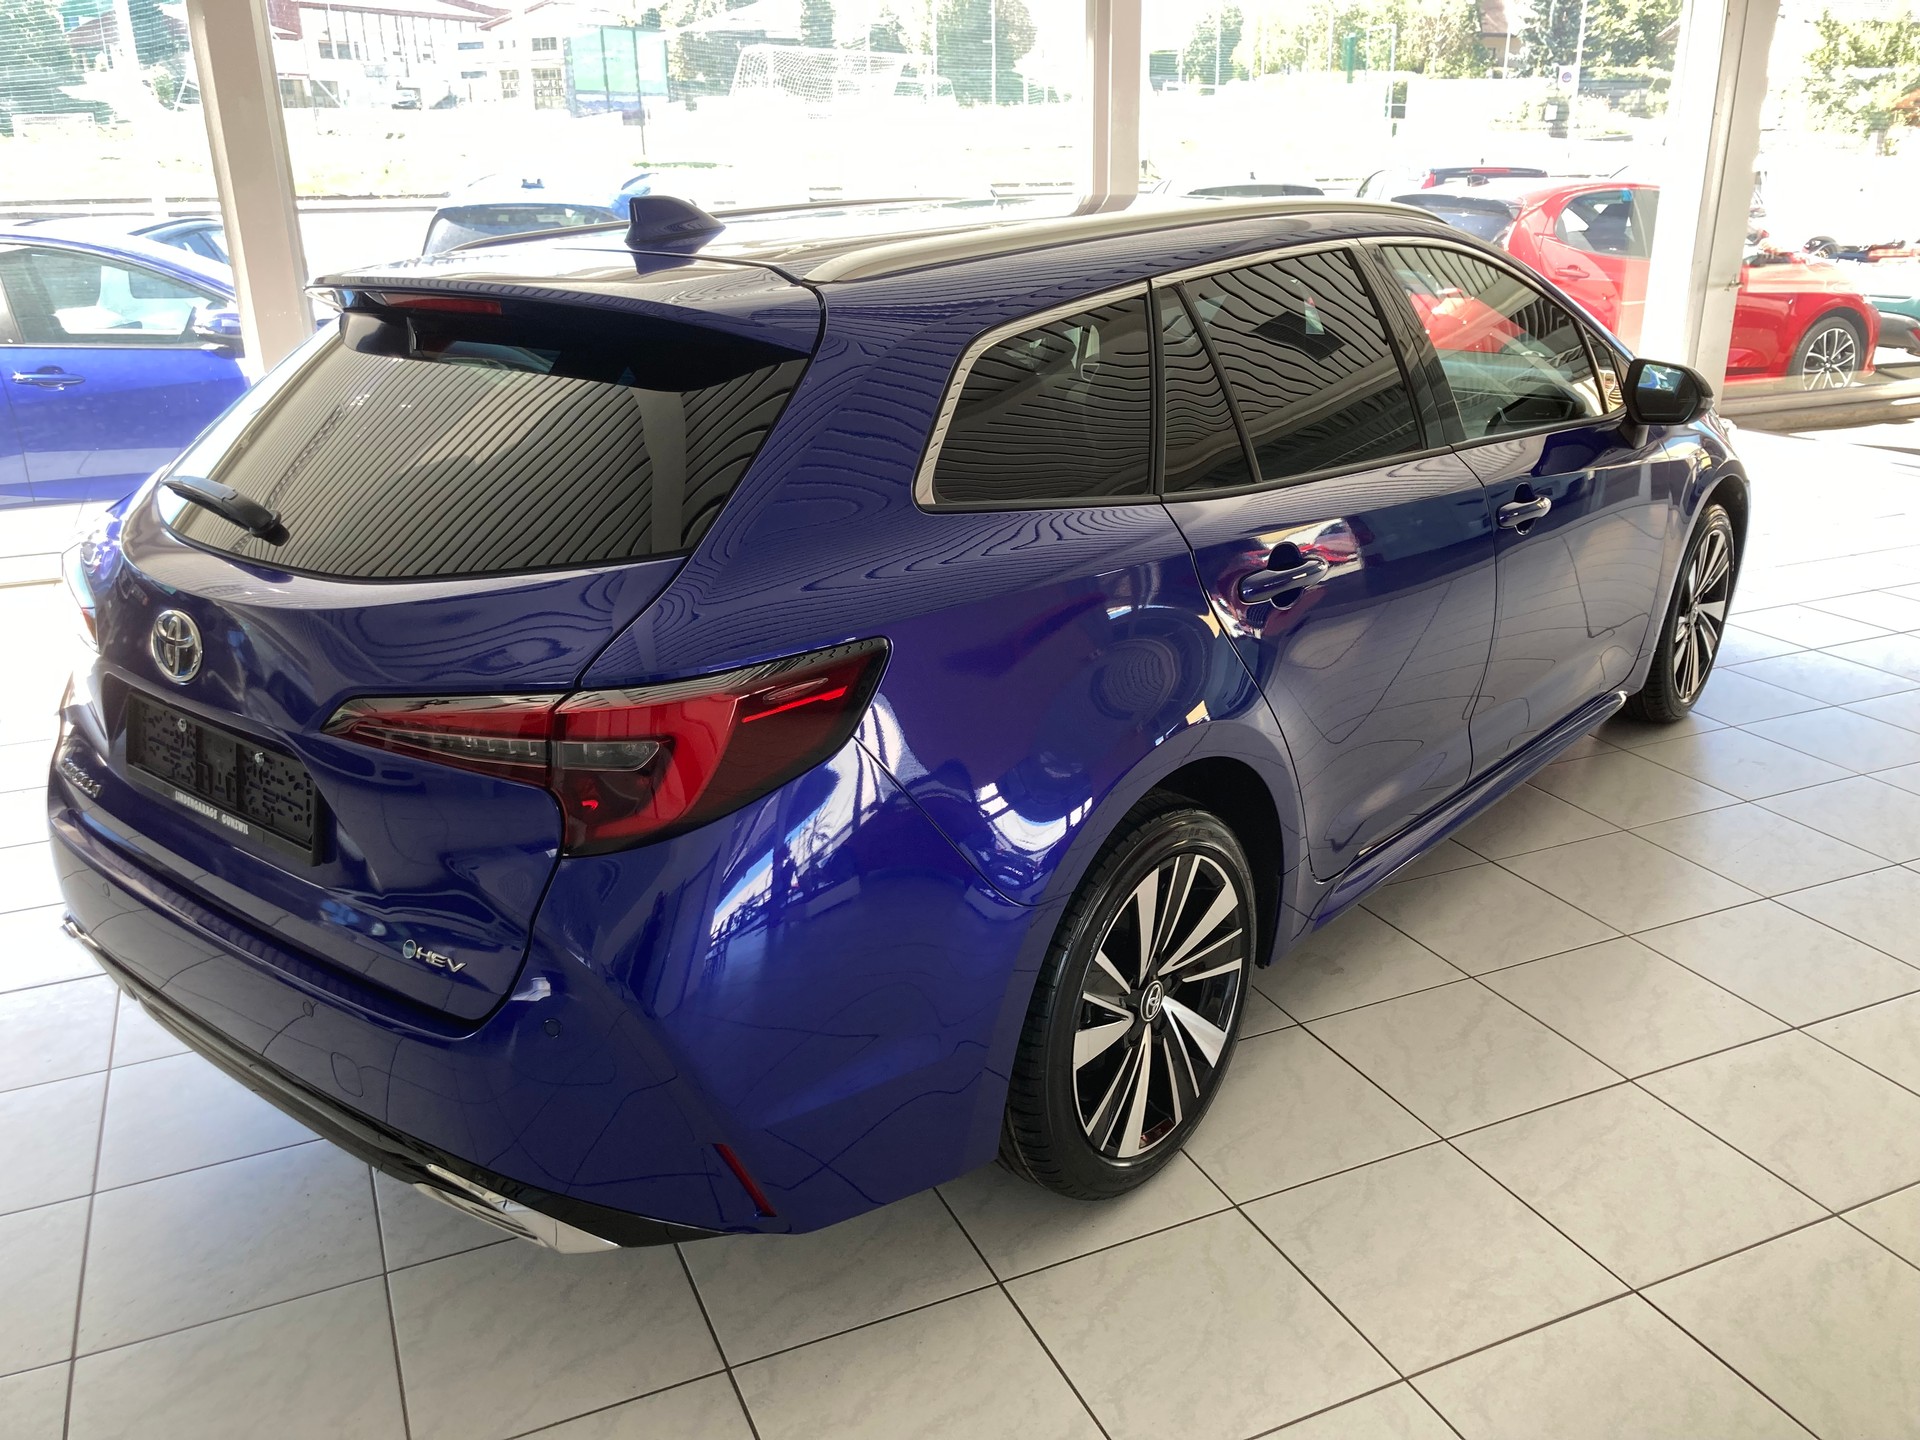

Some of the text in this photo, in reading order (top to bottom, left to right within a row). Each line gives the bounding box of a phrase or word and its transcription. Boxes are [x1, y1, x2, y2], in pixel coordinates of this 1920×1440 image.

[175, 790, 249, 835] LINDENGARAGE GUNZWIL
[416, 946, 467, 973] HEV
